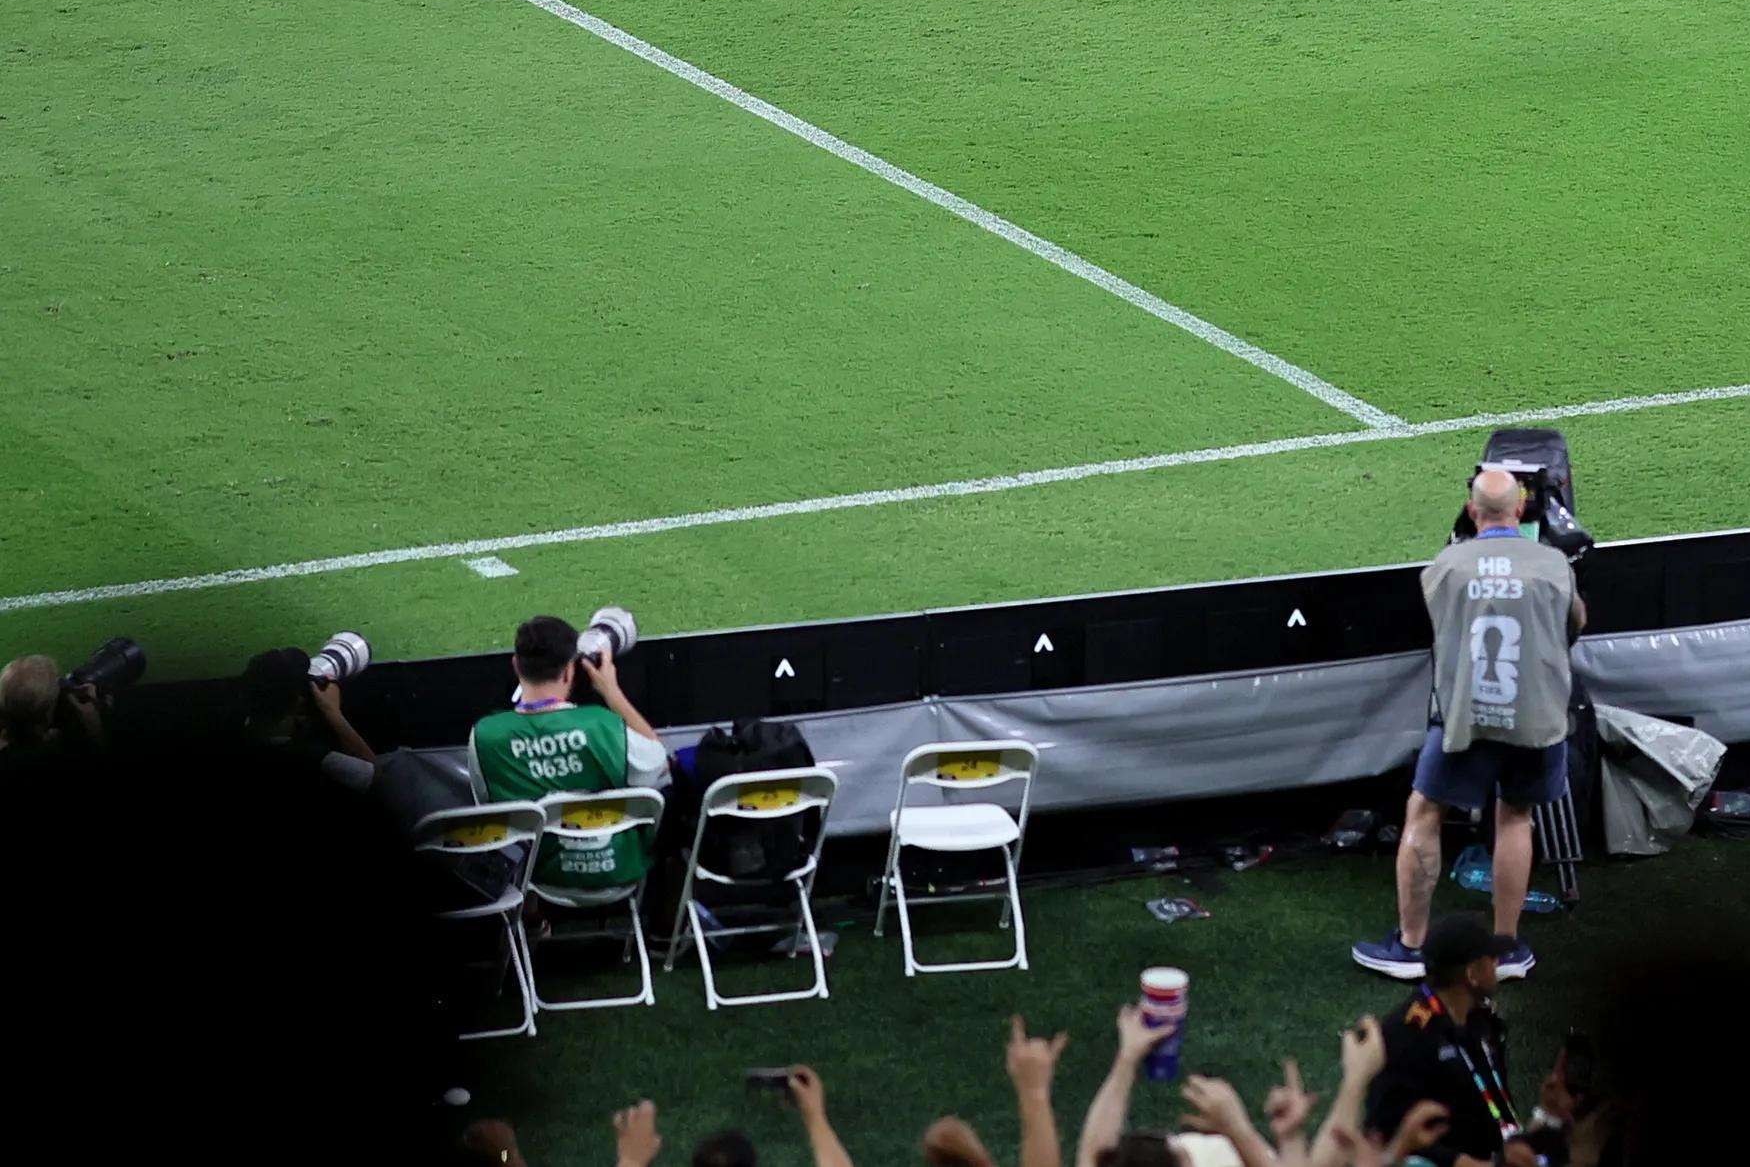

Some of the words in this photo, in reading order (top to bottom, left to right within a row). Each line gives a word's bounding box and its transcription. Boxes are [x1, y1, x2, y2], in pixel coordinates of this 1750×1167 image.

[1477, 556, 1513, 577] HB
[1467, 578, 1525, 600] 0523
[510, 729, 588, 759] PHOTO
[528, 754, 584, 779] 0636
